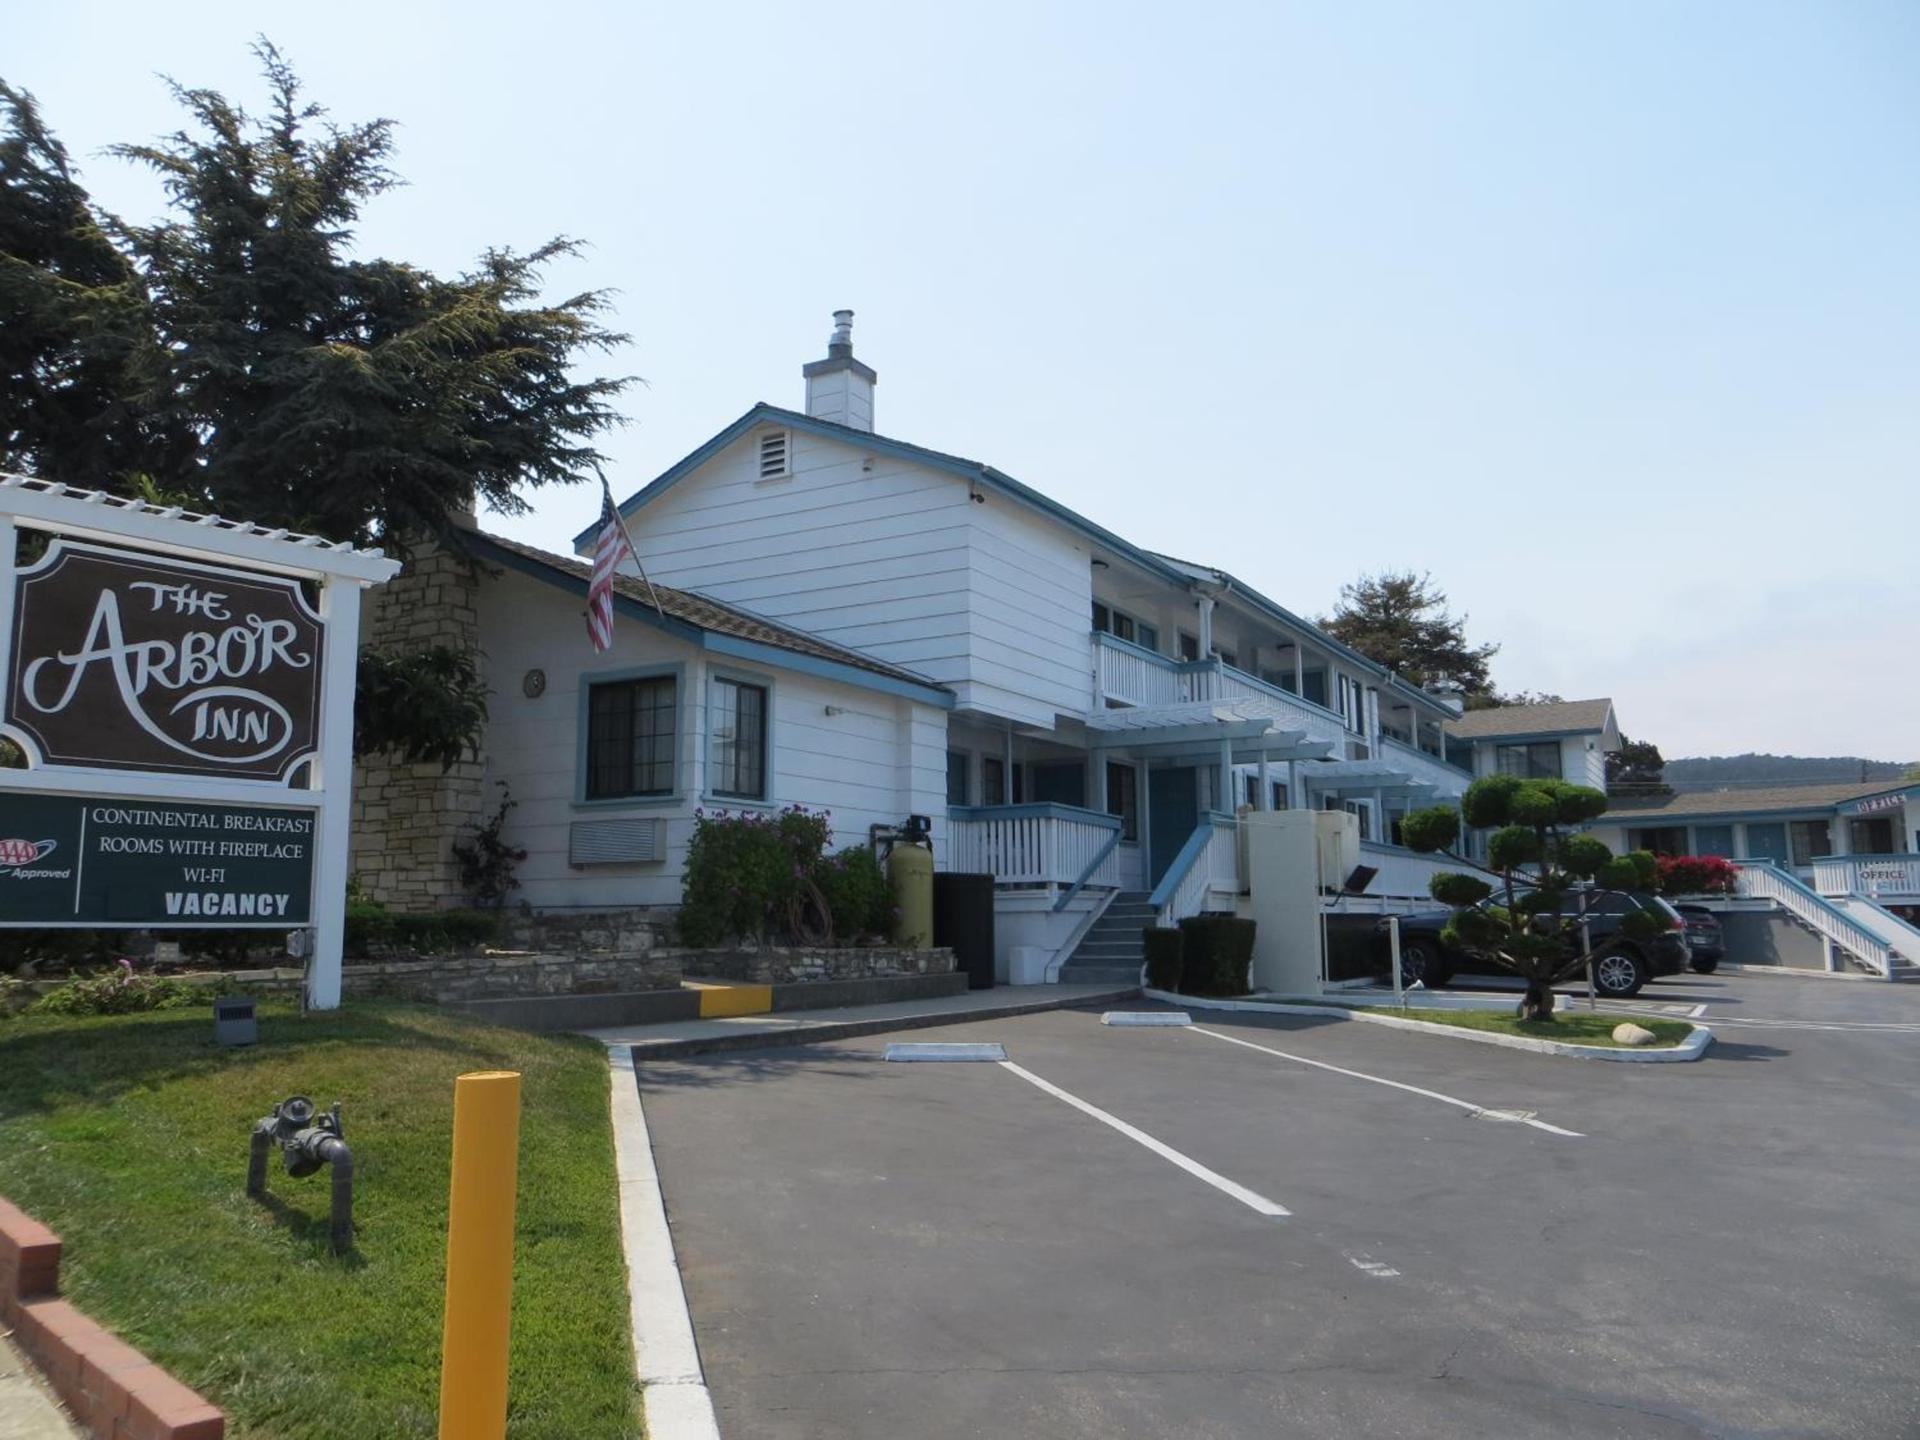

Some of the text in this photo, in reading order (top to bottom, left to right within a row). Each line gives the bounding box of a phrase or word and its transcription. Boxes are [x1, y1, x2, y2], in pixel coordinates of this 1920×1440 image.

[130, 581, 231, 620] THE
[23, 588, 311, 762] ARBOR
[191, 702, 270, 744] INN
[92, 808, 313, 833] CONTINENTAL BREAKFAST
[100, 836, 303, 859] ROOMS WITH FIREPLACE
[11, 868, 71, 880] Approved
[183, 867, 226, 883] WI-FI
[1860, 870, 1904, 880] OFFICE
[165, 892, 290, 914] VACANCY
